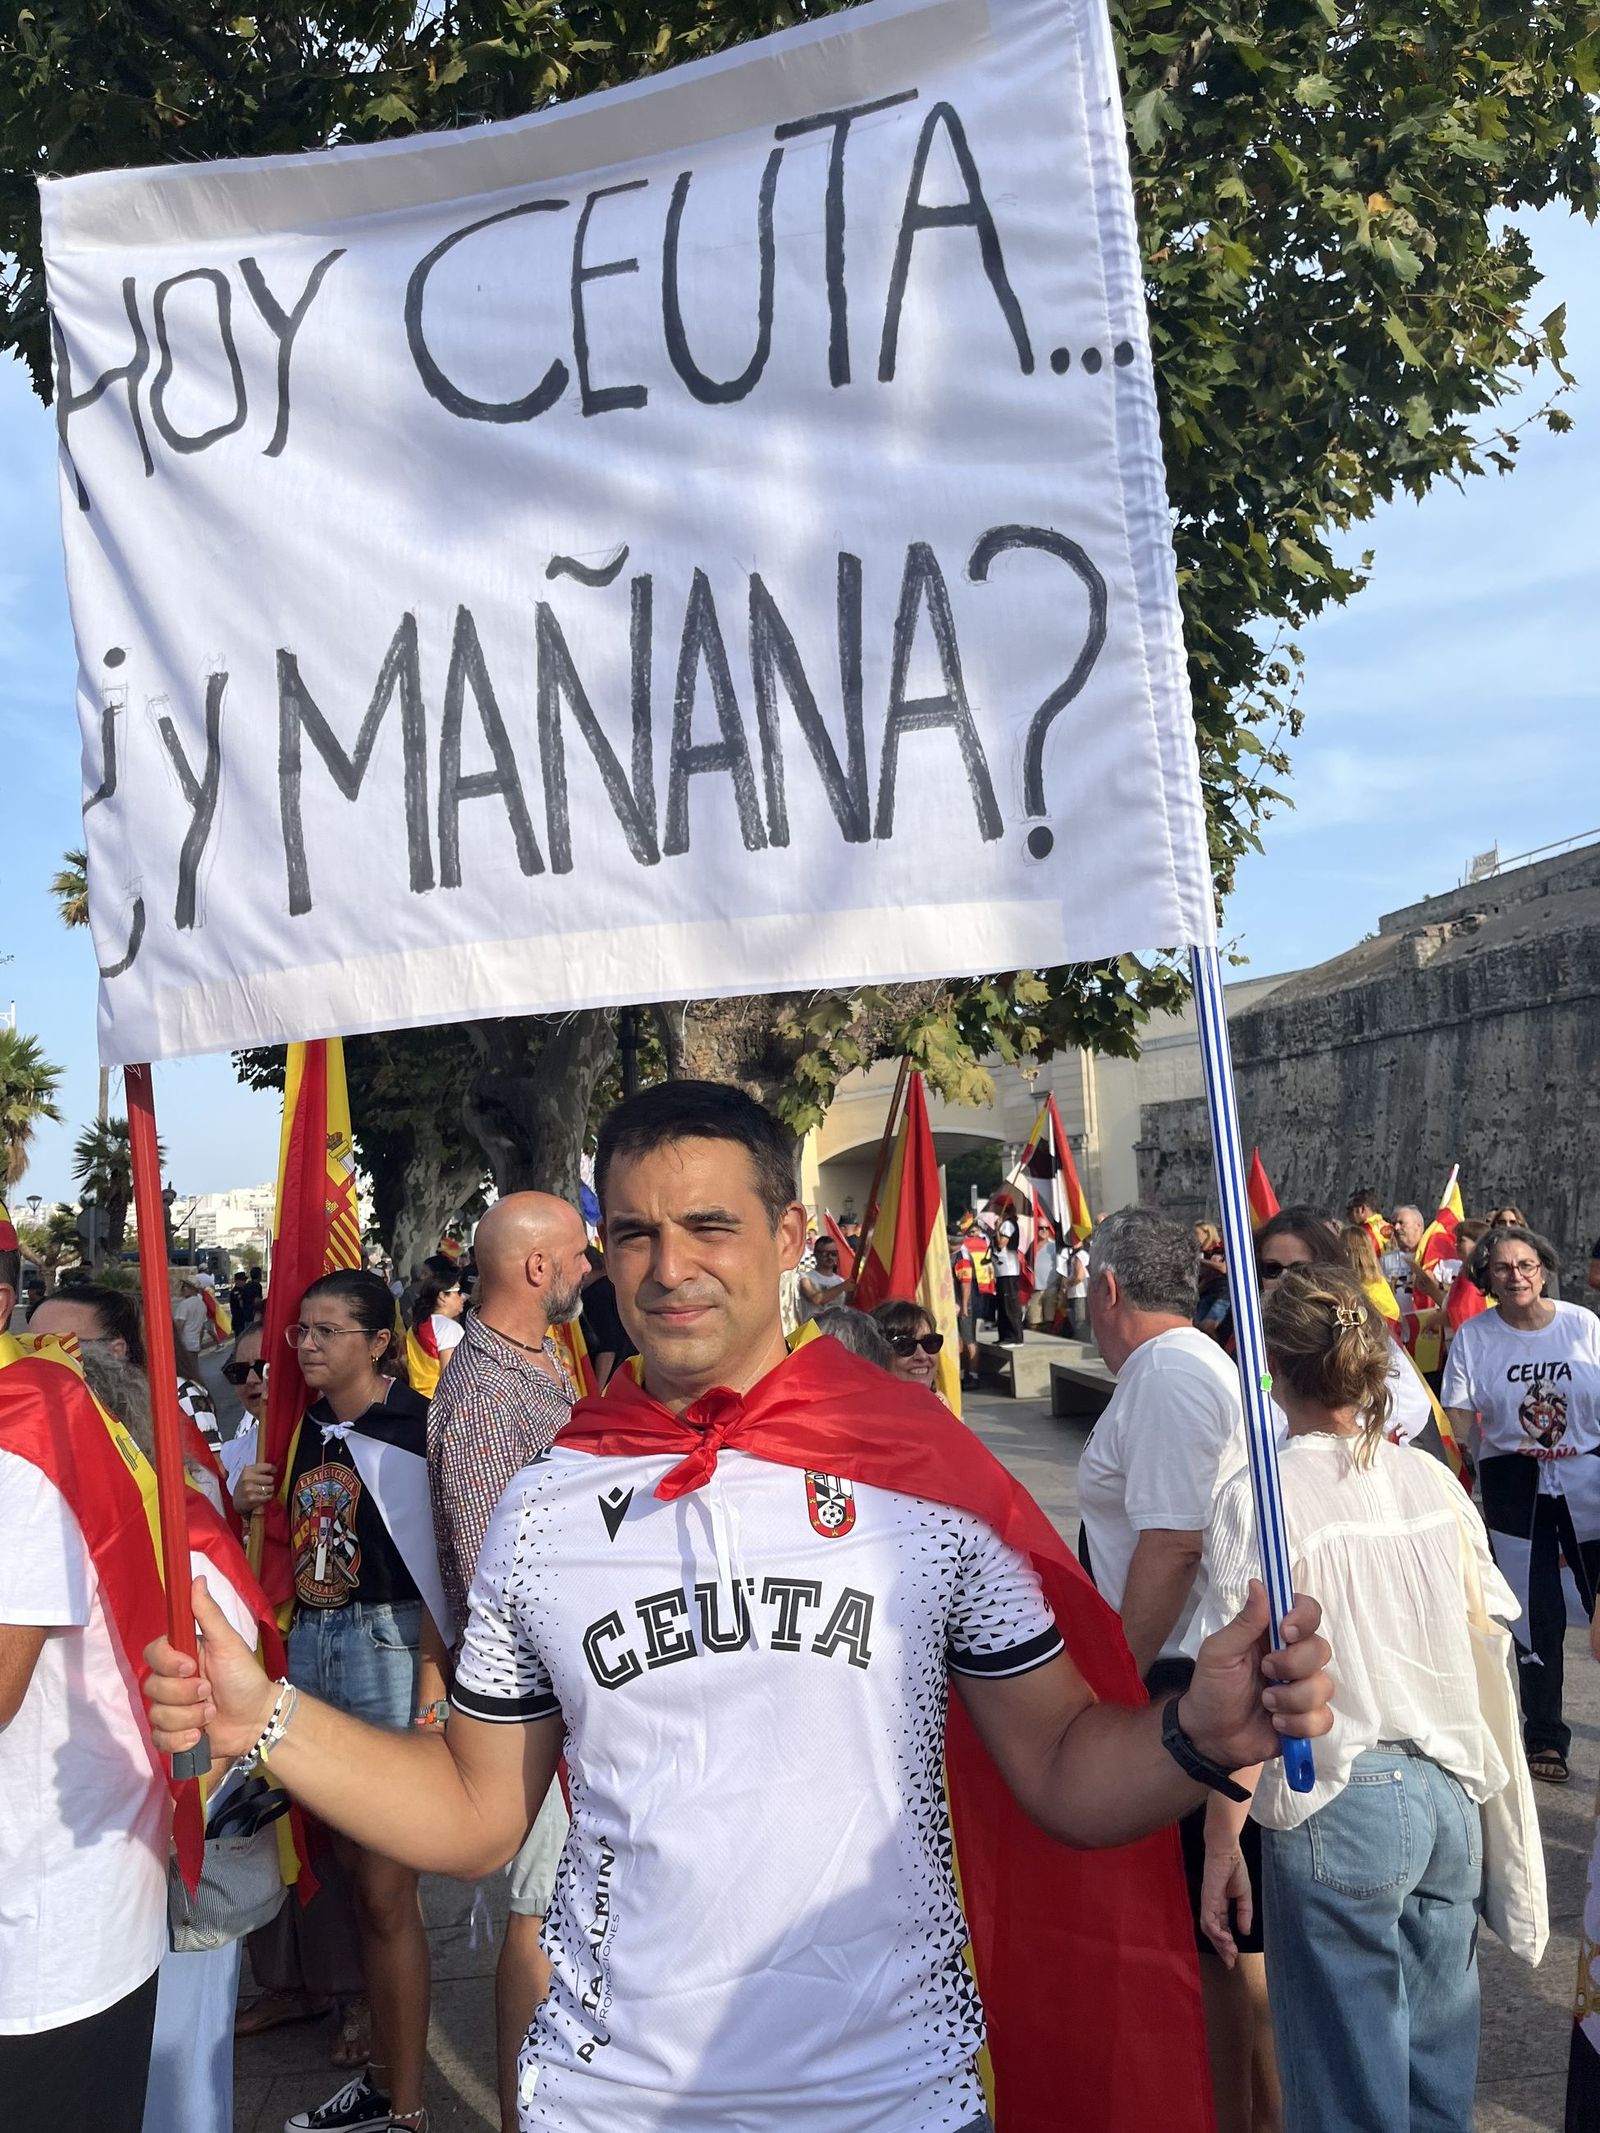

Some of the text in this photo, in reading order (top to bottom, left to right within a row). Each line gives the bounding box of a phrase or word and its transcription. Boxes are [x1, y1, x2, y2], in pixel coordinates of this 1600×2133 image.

[49, 88, 1136, 512] HOY CEUTA...
[275, 523, 1109, 917] MAÑANA?
[1507, 1361, 1572, 1383] CEUTA
[582, 1576, 875, 1691] CEUTA
[576, 1835, 616, 2065] PUTA ALMINA
[598, 1913, 621, 2029] PROMOCIONES
